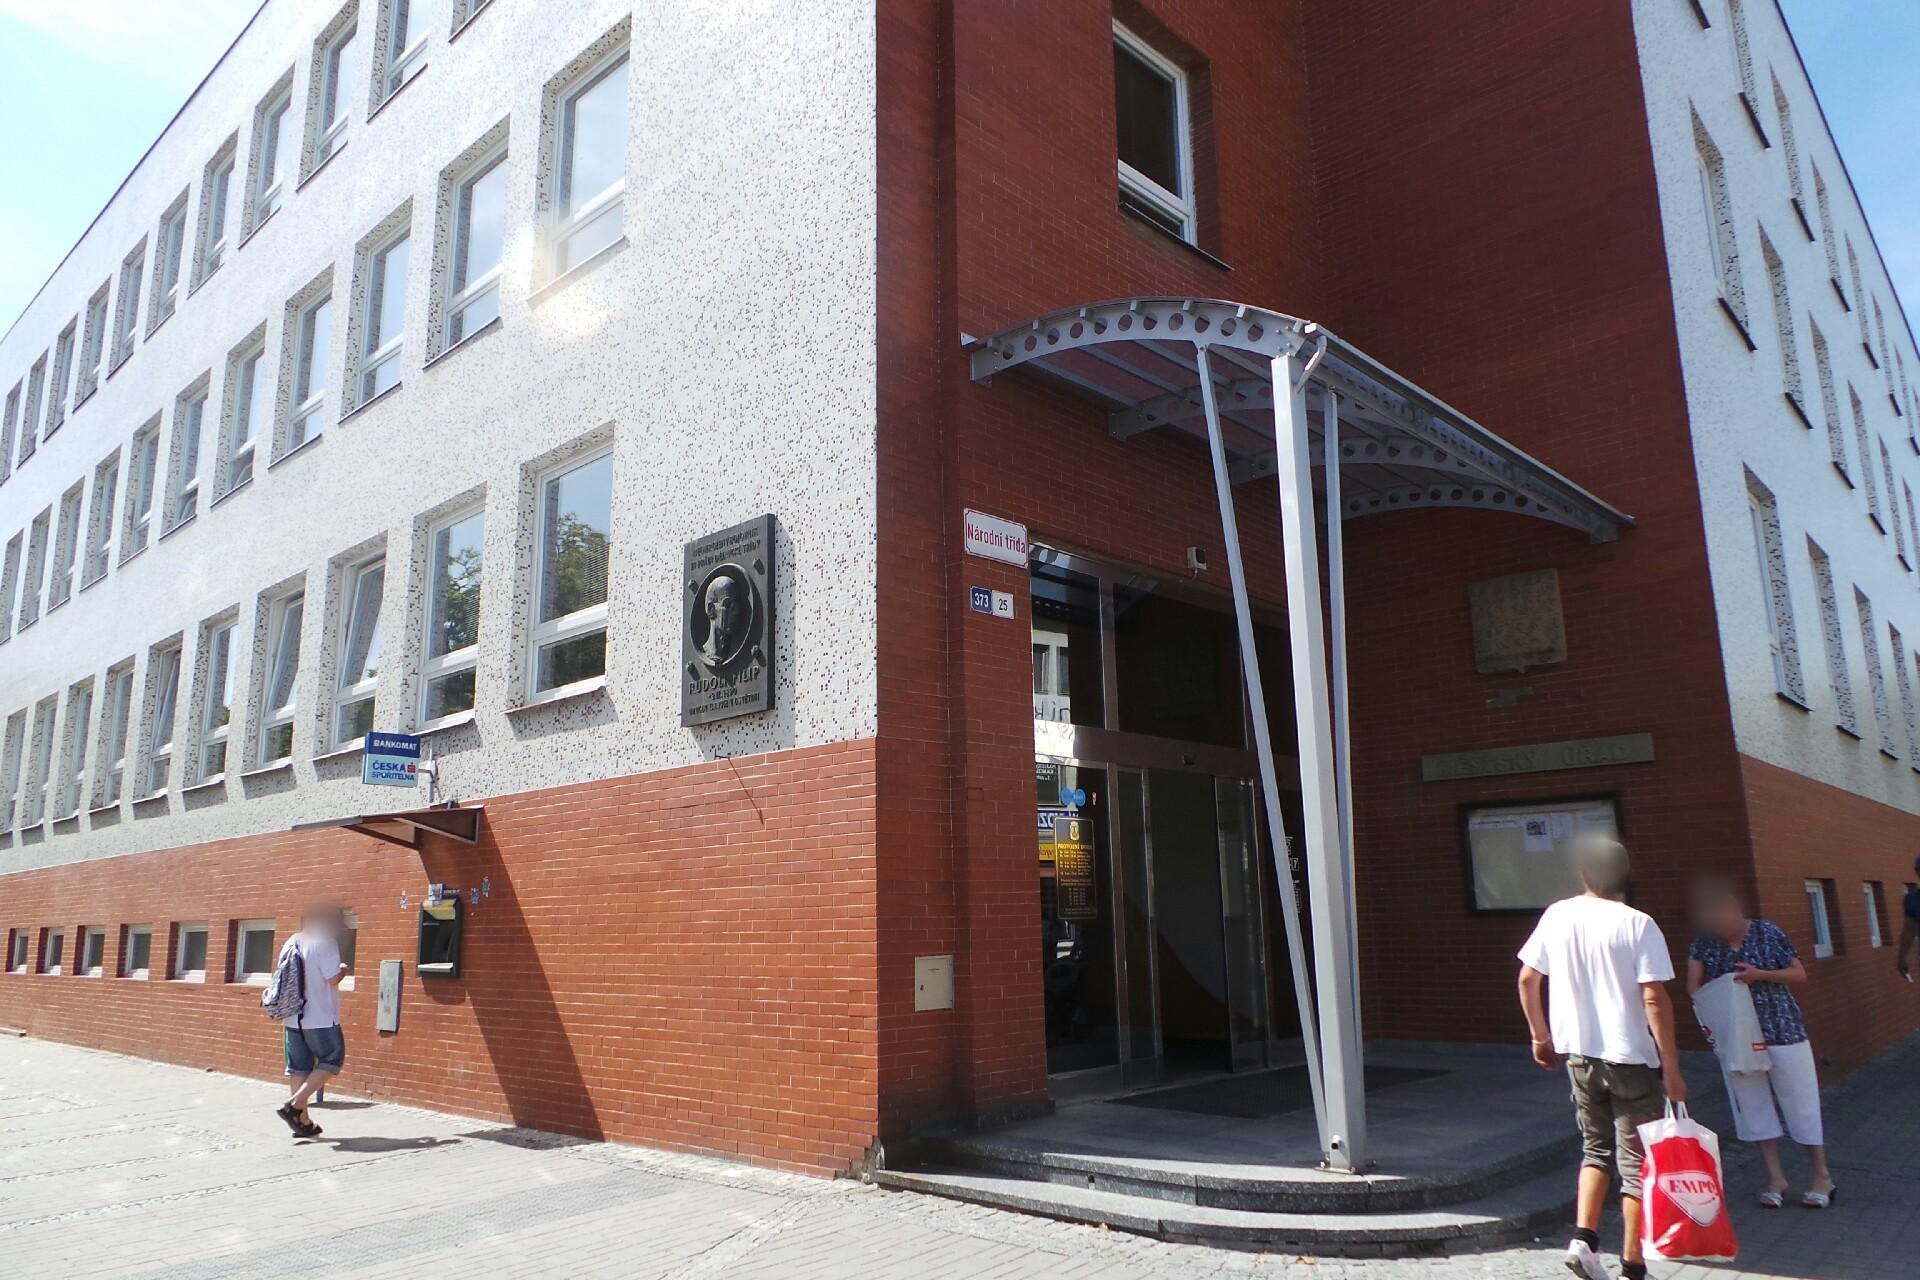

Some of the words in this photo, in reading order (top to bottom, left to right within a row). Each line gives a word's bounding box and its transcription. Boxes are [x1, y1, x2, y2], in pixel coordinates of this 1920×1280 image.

[967, 523, 1002, 547] Národní
[1005, 533, 1026, 554] třída
[974, 592, 989, 608] 373
[998, 598, 1008, 611] 25
[373, 739, 417, 751] BANKOMAT
[372, 760, 406, 773] ČESKÁ
[371, 771, 415, 781] SPOŘITELNA
[1669, 1179, 1719, 1196] EMPO
